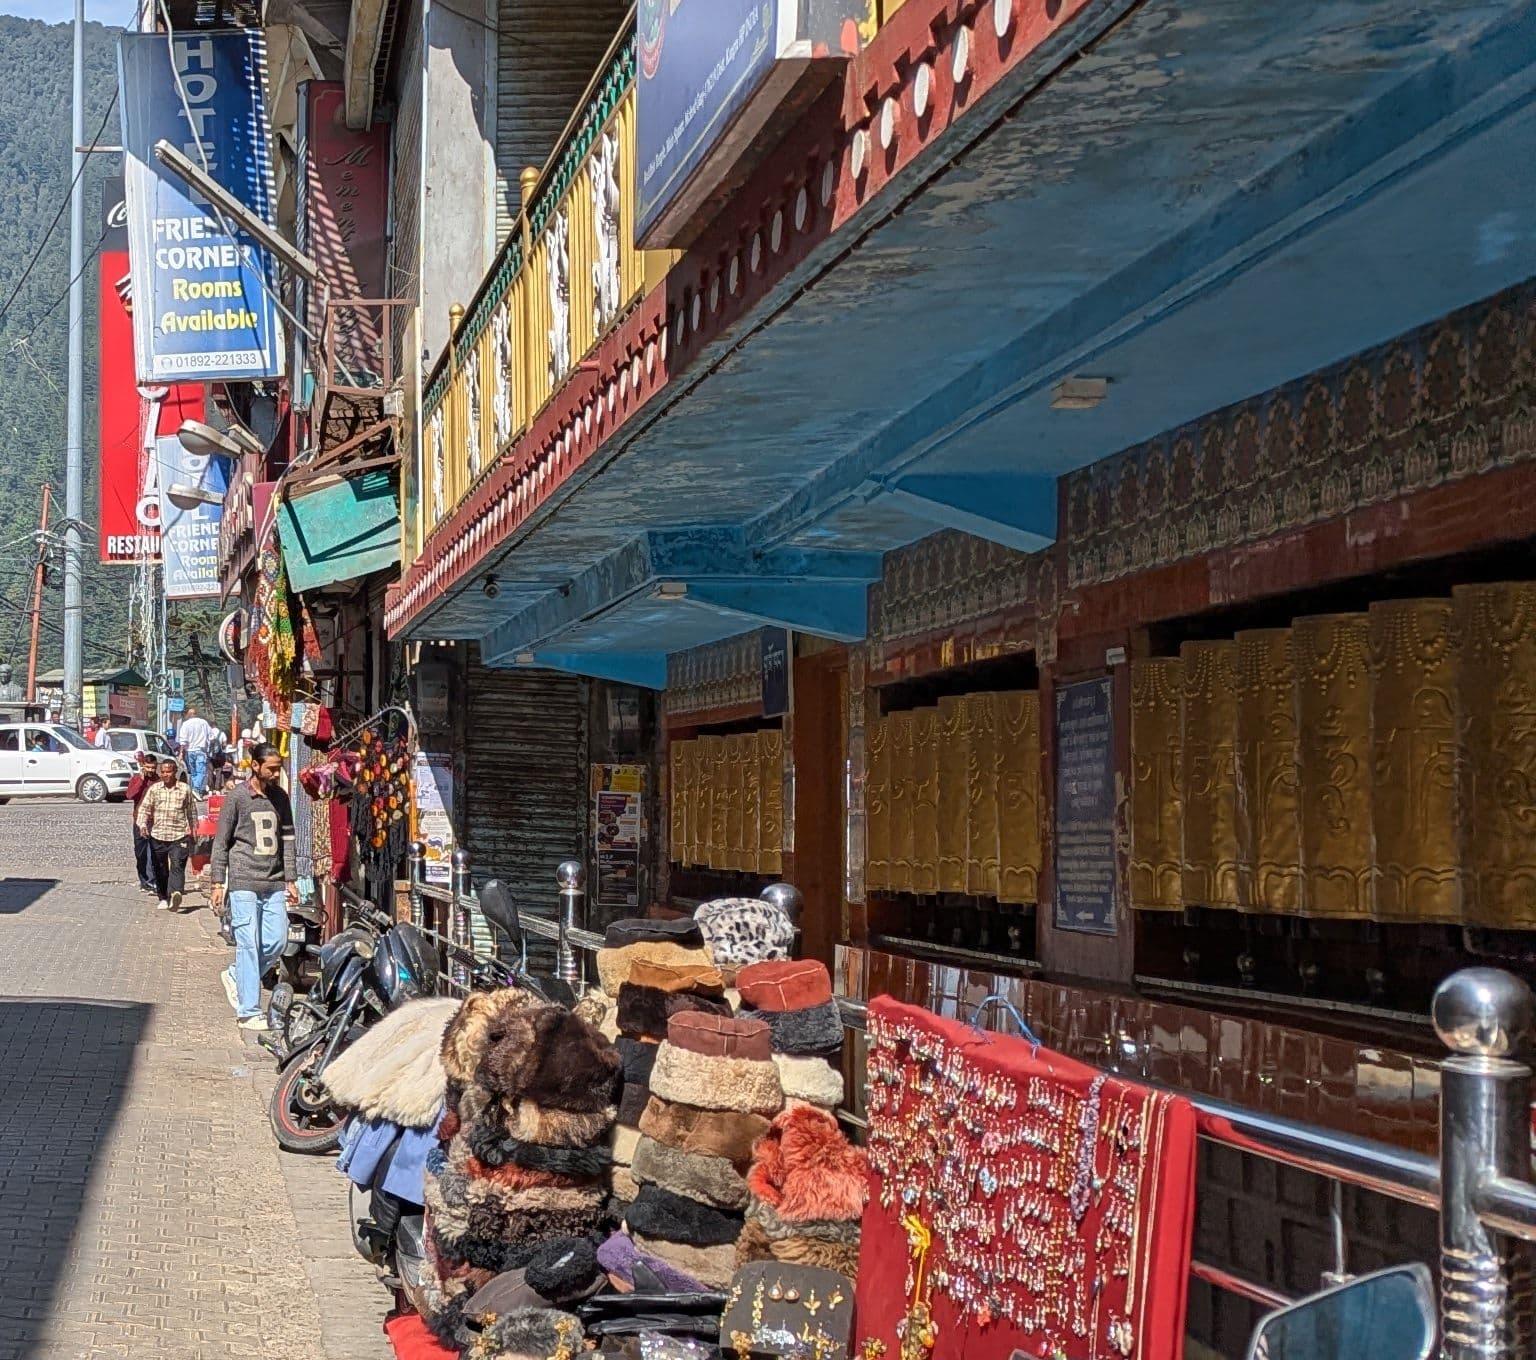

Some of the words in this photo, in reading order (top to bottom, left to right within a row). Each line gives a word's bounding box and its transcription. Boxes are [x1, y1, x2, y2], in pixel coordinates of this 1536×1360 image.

[153, 216, 251, 242] FRIEND
[156, 245, 252, 271] CORNER
[172, 278, 243, 302] Rooms
[160, 308, 258, 334] Available
[176, 353, 257, 368] 01892-221333
[107, 535, 163, 554] RESTAU
[251, 811, 278, 856] B
